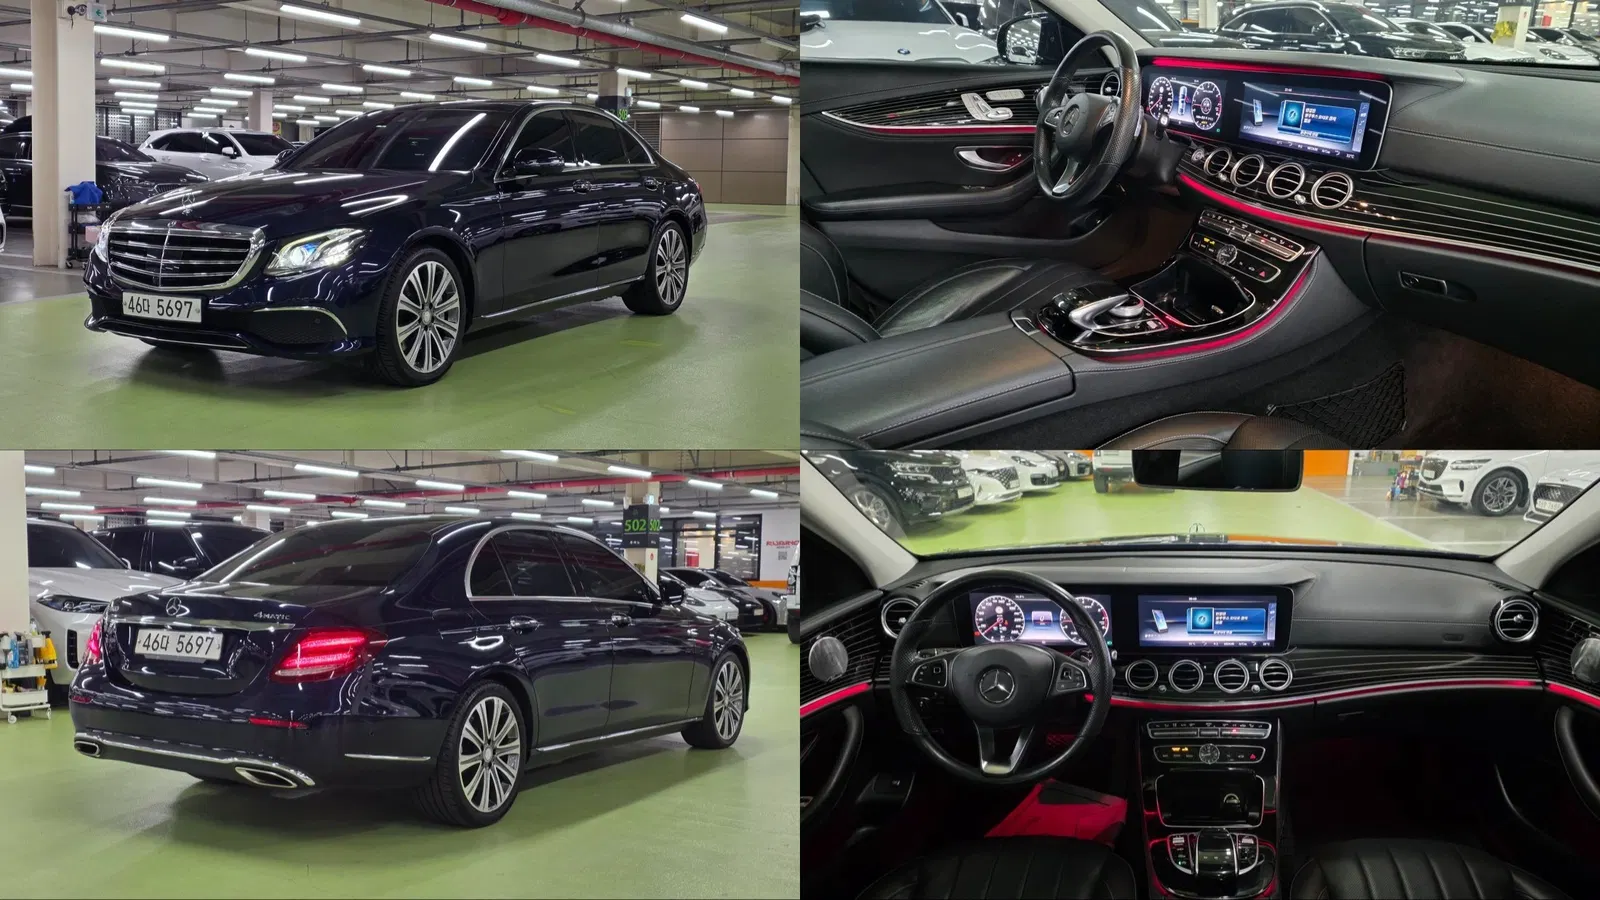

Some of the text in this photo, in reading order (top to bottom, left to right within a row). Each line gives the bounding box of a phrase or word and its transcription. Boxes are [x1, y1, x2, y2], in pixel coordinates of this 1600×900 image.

[157, 299, 193, 318] 5697
[624, 519, 647, 532] 502
[253, 611, 291, 620] 4MATIC
[176, 634, 214, 655] 5697
